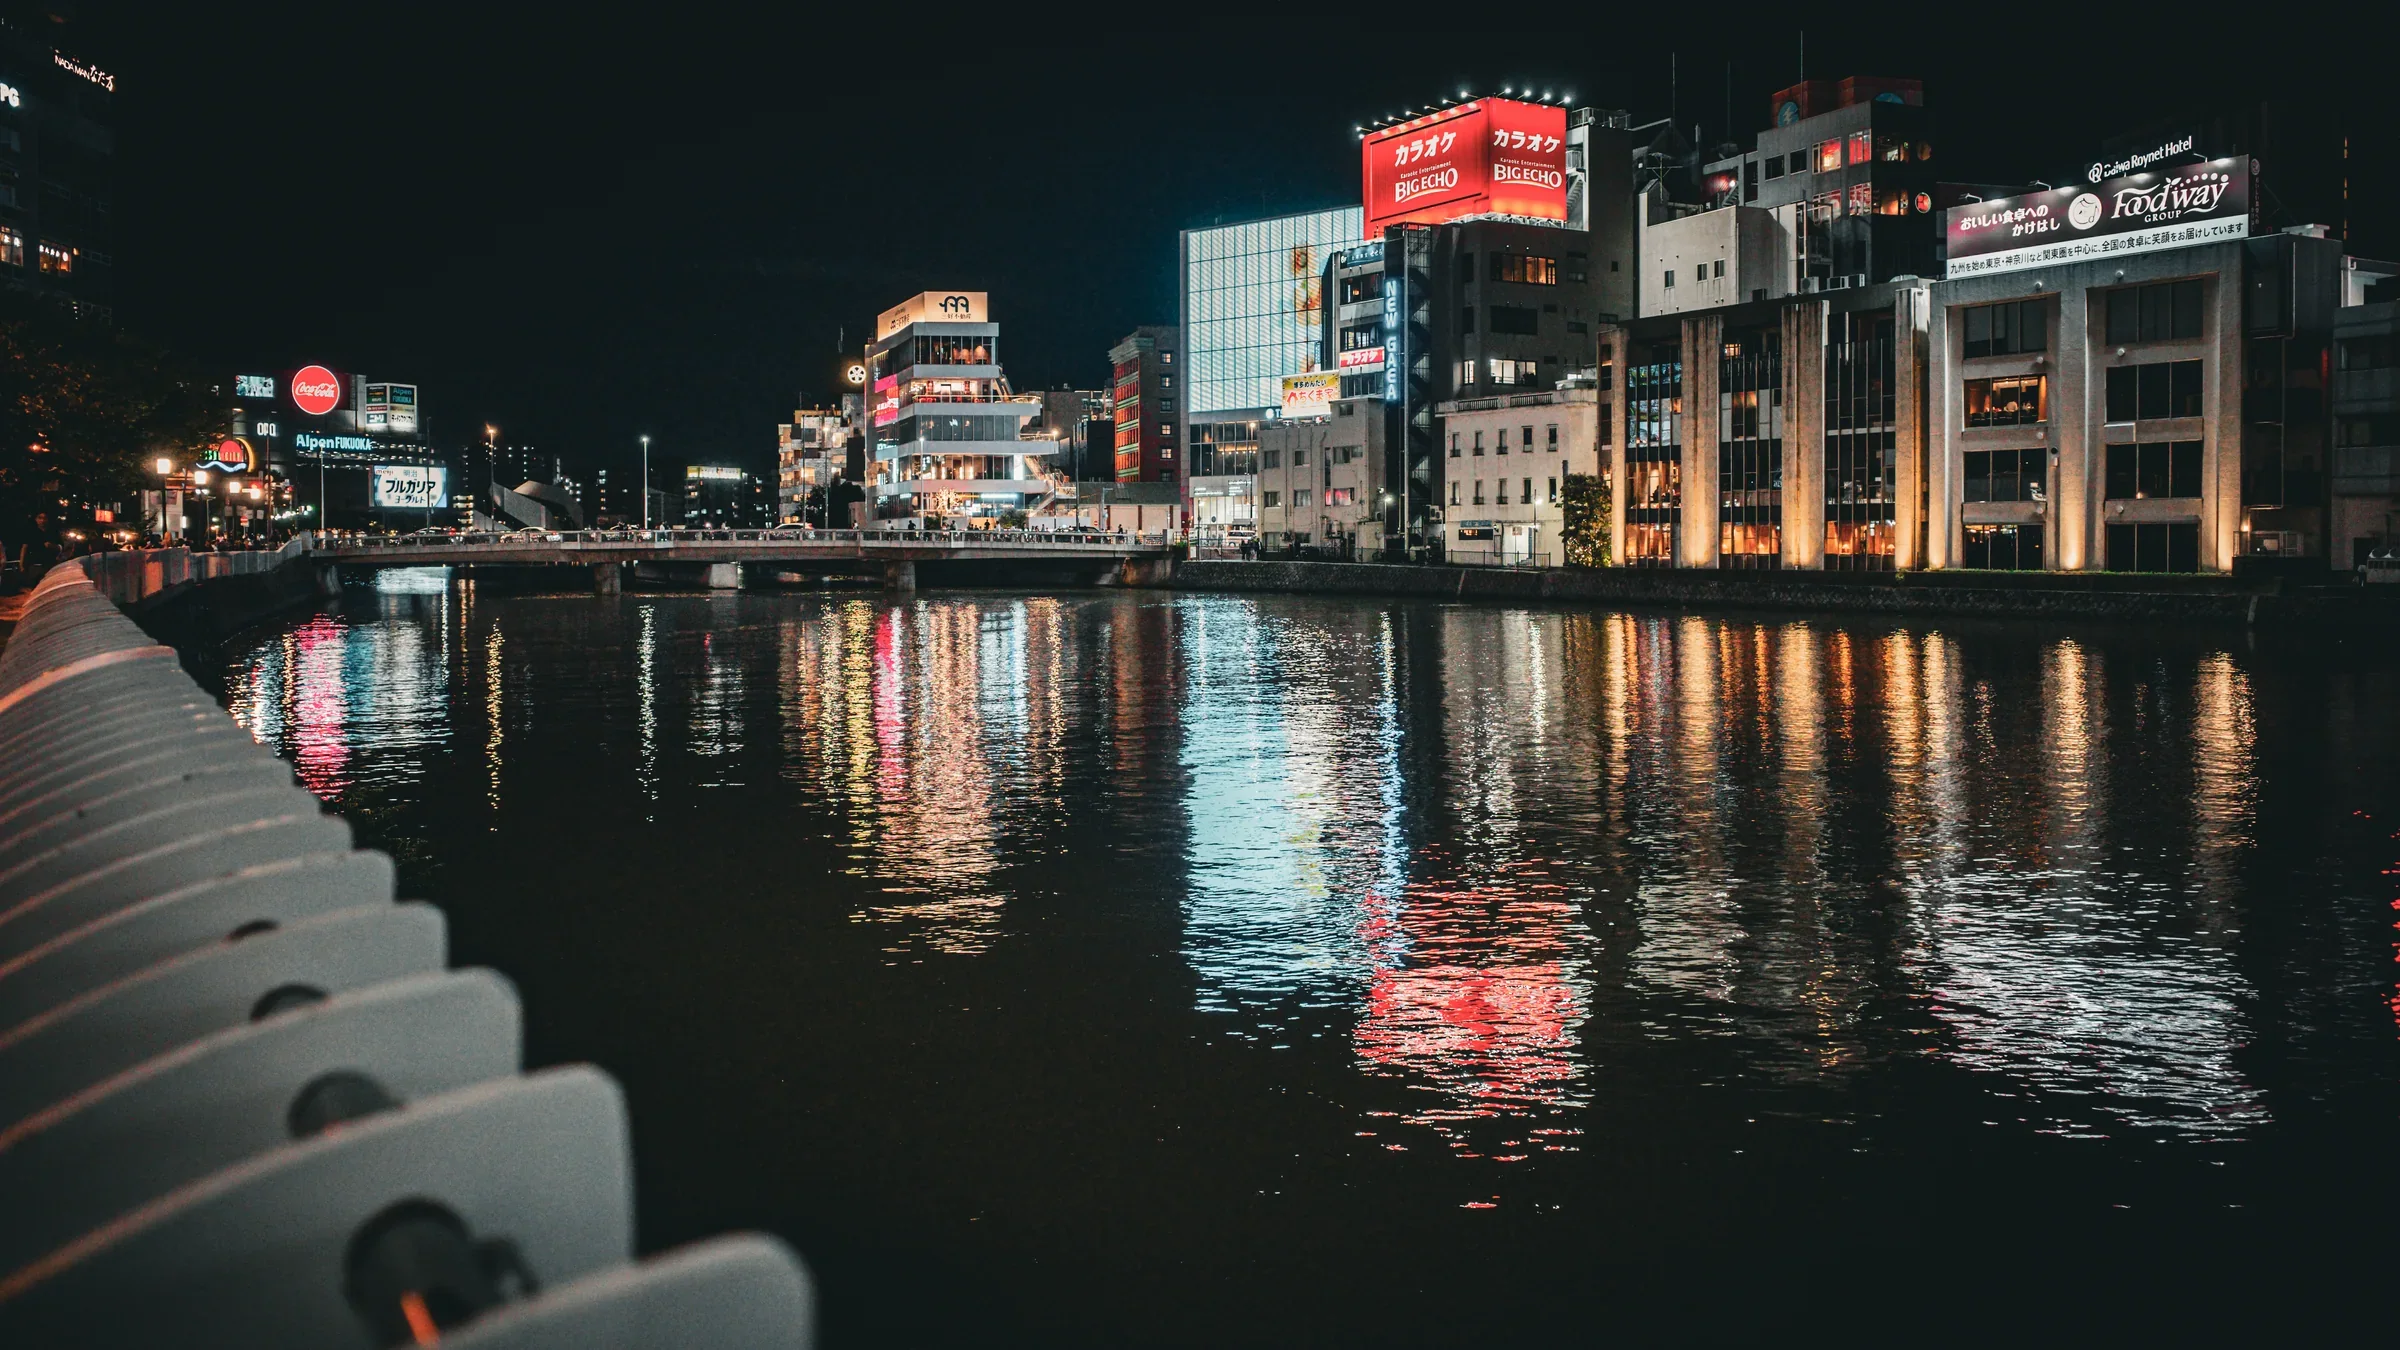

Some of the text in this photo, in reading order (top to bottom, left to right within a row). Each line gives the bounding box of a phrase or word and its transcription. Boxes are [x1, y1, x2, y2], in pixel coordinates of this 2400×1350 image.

[1395, 132, 1457, 168] カラオケ
[1494, 129, 1561, 154] カラオケ
[2131, 146, 2164, 169] Roynet
[2165, 135, 2192, 157] Hotel
[1400, 161, 1451, 179] Karaoke Entertainment
[1500, 157, 1556, 169] Karaoke Entertainment
[1493, 163, 1563, 188] BIG ECHO
[1395, 167, 1459, 203] BIG ECHO
[2111, 178, 2229, 219] Foodway
[1960, 204, 2048, 231] おいしい食卓への
[2144, 209, 2182, 223] GROUP
[2012, 218, 2061, 237] かけはし
[1384, 280, 1398, 400] NEW GAEA
[1347, 350, 1378, 365] カラオケ
[295, 381, 337, 398] Coca-Cola
[1293, 379, 1327, 389] 博多めんたい
[296, 434, 372, 451] Alpen FUKUOKA
[386, 477, 436, 494] ブルガリア
[395, 495, 426, 504] ヨーグルト
